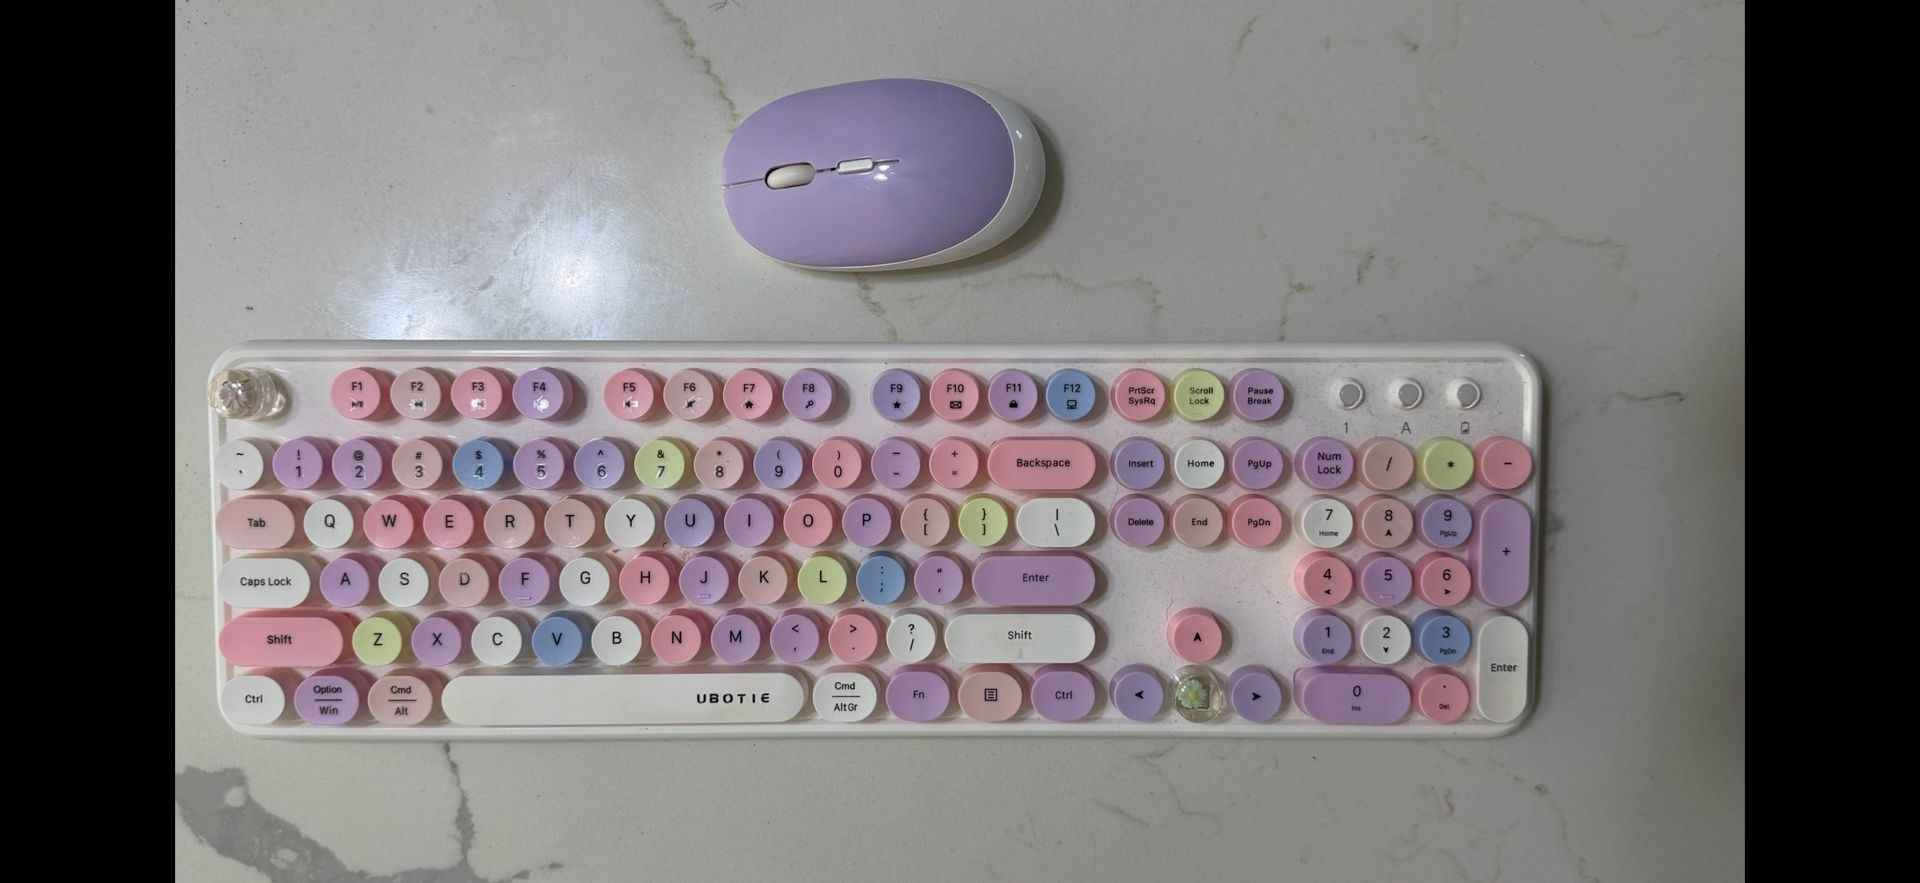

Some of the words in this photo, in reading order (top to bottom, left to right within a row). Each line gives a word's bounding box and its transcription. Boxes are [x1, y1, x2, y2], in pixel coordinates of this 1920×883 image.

[351, 381, 363, 391] F1
[410, 381, 424, 392] F2
[471, 381, 485, 392] F3
[532, 381, 547, 392] F4
[622, 382, 636, 393] F5
[683, 382, 697, 393] F6
[743, 383, 756, 393] F7
[802, 383, 816, 393] F8
[890, 383, 904, 393] F9
[946, 383, 965, 394] F10
[1005, 383, 1022, 393] F11
[1063, 383, 1081, 393] F12
[1128, 386, 1155, 396] PrtScr
[1189, 386, 1214, 395] Scroll
[1247, 386, 1274, 395] Pause
[1128, 395, 1156, 406] SysRq
[1189, 397, 1210, 405] Lock
[1247, 397, 1272, 405] Break
[1400, 421, 1412, 435] A
[1317, 451, 1342, 461] Num
[1016, 457, 1071, 469] Backspace
[1128, 460, 1154, 468] Insert
[1187, 459, 1215, 468] Home
[1247, 459, 1272, 470] PgUp
[354, 465, 364, 478] 2
[415, 465, 424, 478] 3
[475, 465, 484, 478] 4
[536, 465, 546, 479] 5
[597, 464, 607, 478] 6
[657, 465, 666, 478] 7
[715, 465, 725, 478] 8
[774, 465, 784, 478] 9
[833, 465, 843, 478] 0
[1317, 464, 1342, 475] Lock
[625, 513, 636, 528] Y
[684, 513, 696, 528] U
[802, 513, 814, 528] O
[862, 513, 872, 527] P
[1325, 508, 1334, 521] 7
[1384, 509, 1394, 522] 8
[1443, 509, 1453, 522] 9
[247, 517, 266, 528] Tab
[324, 513, 336, 529] Q
[381, 514, 397, 528] W
[444, 514, 454, 529] E
[505, 514, 516, 528] R
[564, 514, 576, 528] T
[1127, 517, 1154, 526] Delete
[1191, 517, 1208, 526] End
[1247, 518, 1271, 528] PgDn
[1439, 529, 1458, 538] PgUp
[340, 571, 351, 586] A
[399, 571, 410, 586] S
[459, 572, 471, 586] D
[521, 572, 530, 586] F
[580, 570, 591, 585] G
[640, 570, 651, 584] H
[699, 570, 708, 584] J
[759, 570, 769, 584] K
[819, 569, 828, 584] L
[1022, 573, 1050, 583] Enter
[1322, 568, 1333, 580] 4
[1384, 568, 1393, 582] 5
[1442, 568, 1452, 581] 6
[240, 576, 266, 588] Caps
[268, 576, 292, 587] Lock
[611, 631, 622, 645] B
[671, 630, 682, 645] N
[729, 629, 742, 643] M
[1007, 630, 1032, 640] Shift
[1382, 626, 1391, 639] 2
[1441, 626, 1451, 639] 3
[266, 634, 292, 645] Shift
[373, 632, 384, 647] Z
[432, 632, 443, 646] X
[492, 632, 503, 646] C
[551, 632, 563, 646] V
[1321, 647, 1335, 655] End
[1439, 647, 1457, 656] PgDn
[1490, 662, 1518, 673] Enter
[313, 685, 343, 696] Option
[390, 685, 412, 695] Cmd
[834, 681, 856, 691] Cmd
[1352, 684, 1362, 698] 0
[244, 694, 263, 704] Ctrl
[696, 692, 770, 704] UBOTIE
[913, 689, 925, 699] Fn
[1055, 690, 1073, 700] Ctrl
[319, 705, 339, 715] Win
[394, 706, 409, 716] Alt
